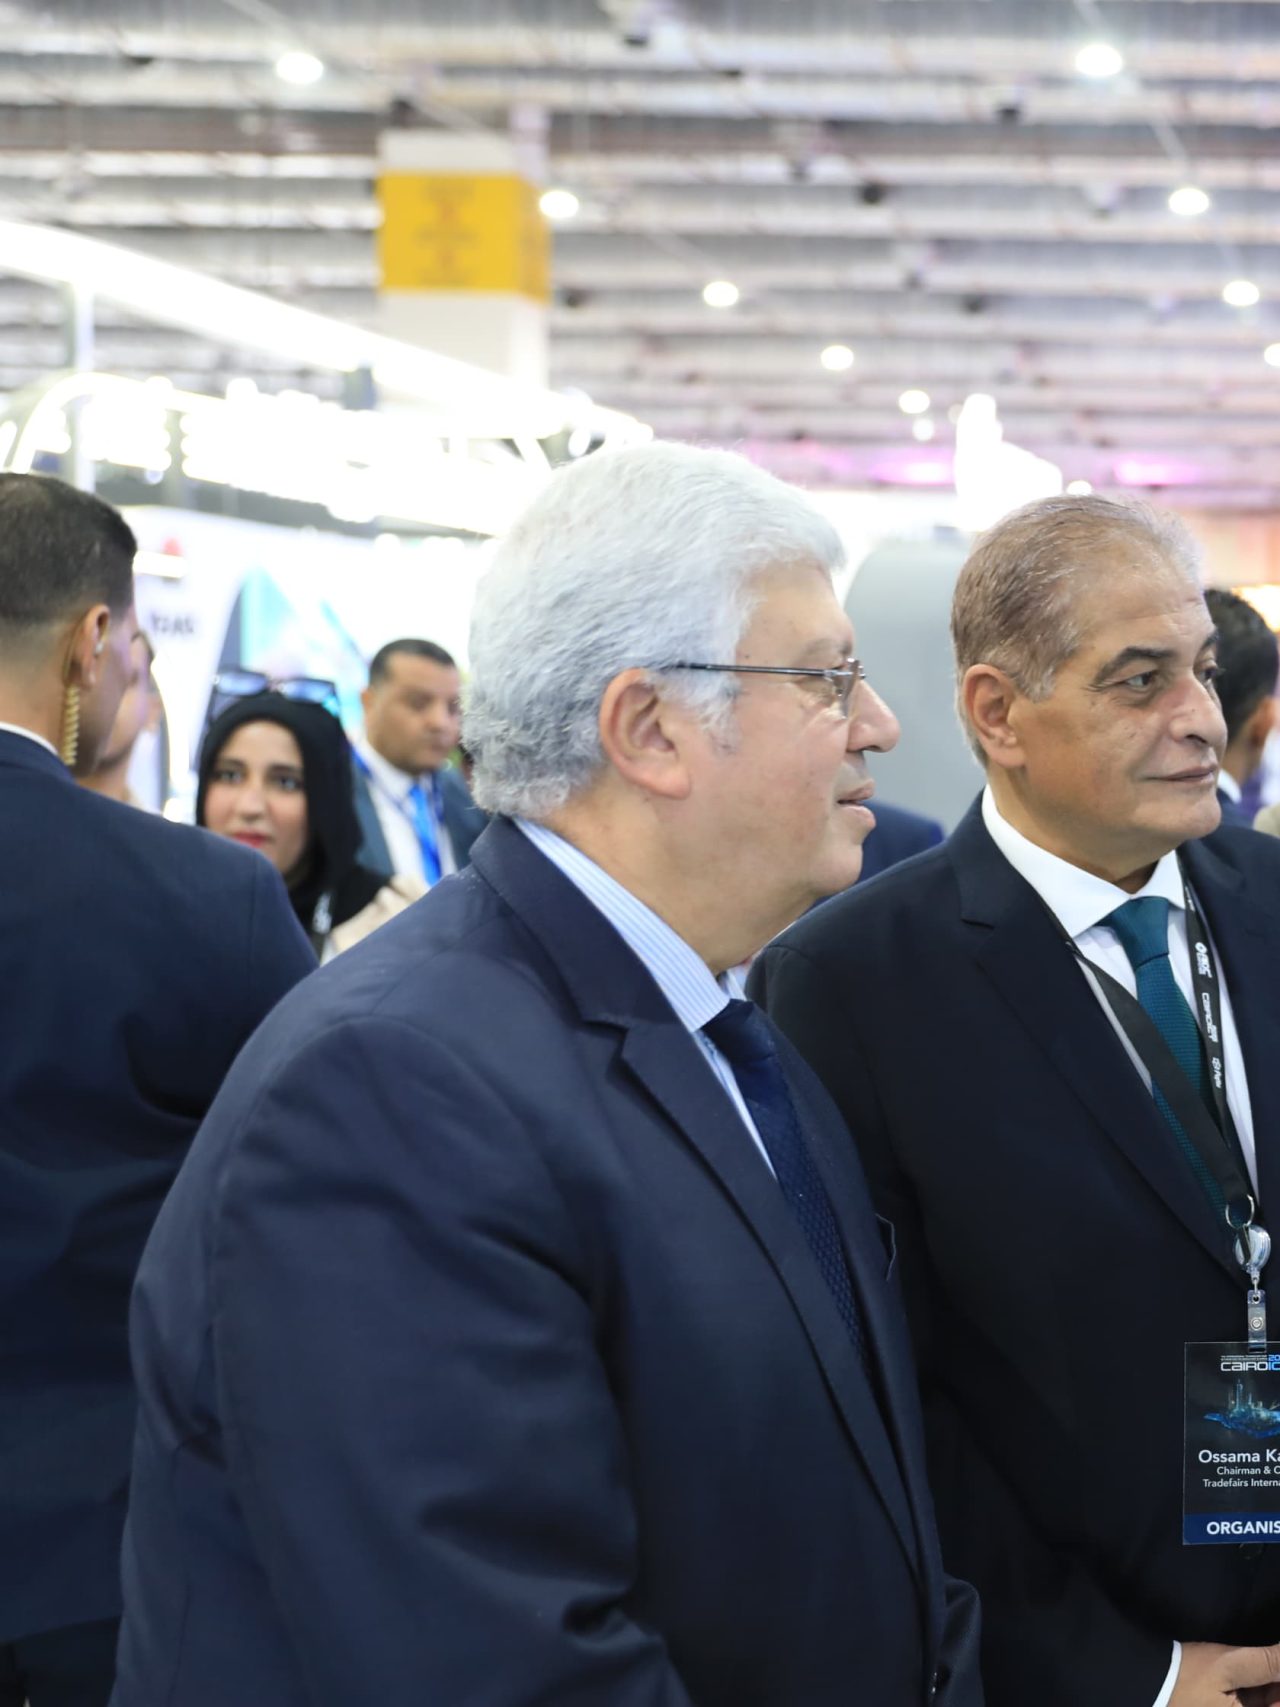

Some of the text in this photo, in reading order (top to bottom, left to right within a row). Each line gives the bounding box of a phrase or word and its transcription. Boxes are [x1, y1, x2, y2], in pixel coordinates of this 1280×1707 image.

[1198, 1449, 1260, 1463] Ossama
[1216, 1466, 1261, 1475] Chairman
[1263, 1466, 1271, 1475] &
[1202, 1478, 1248, 1488] Tradefairs
